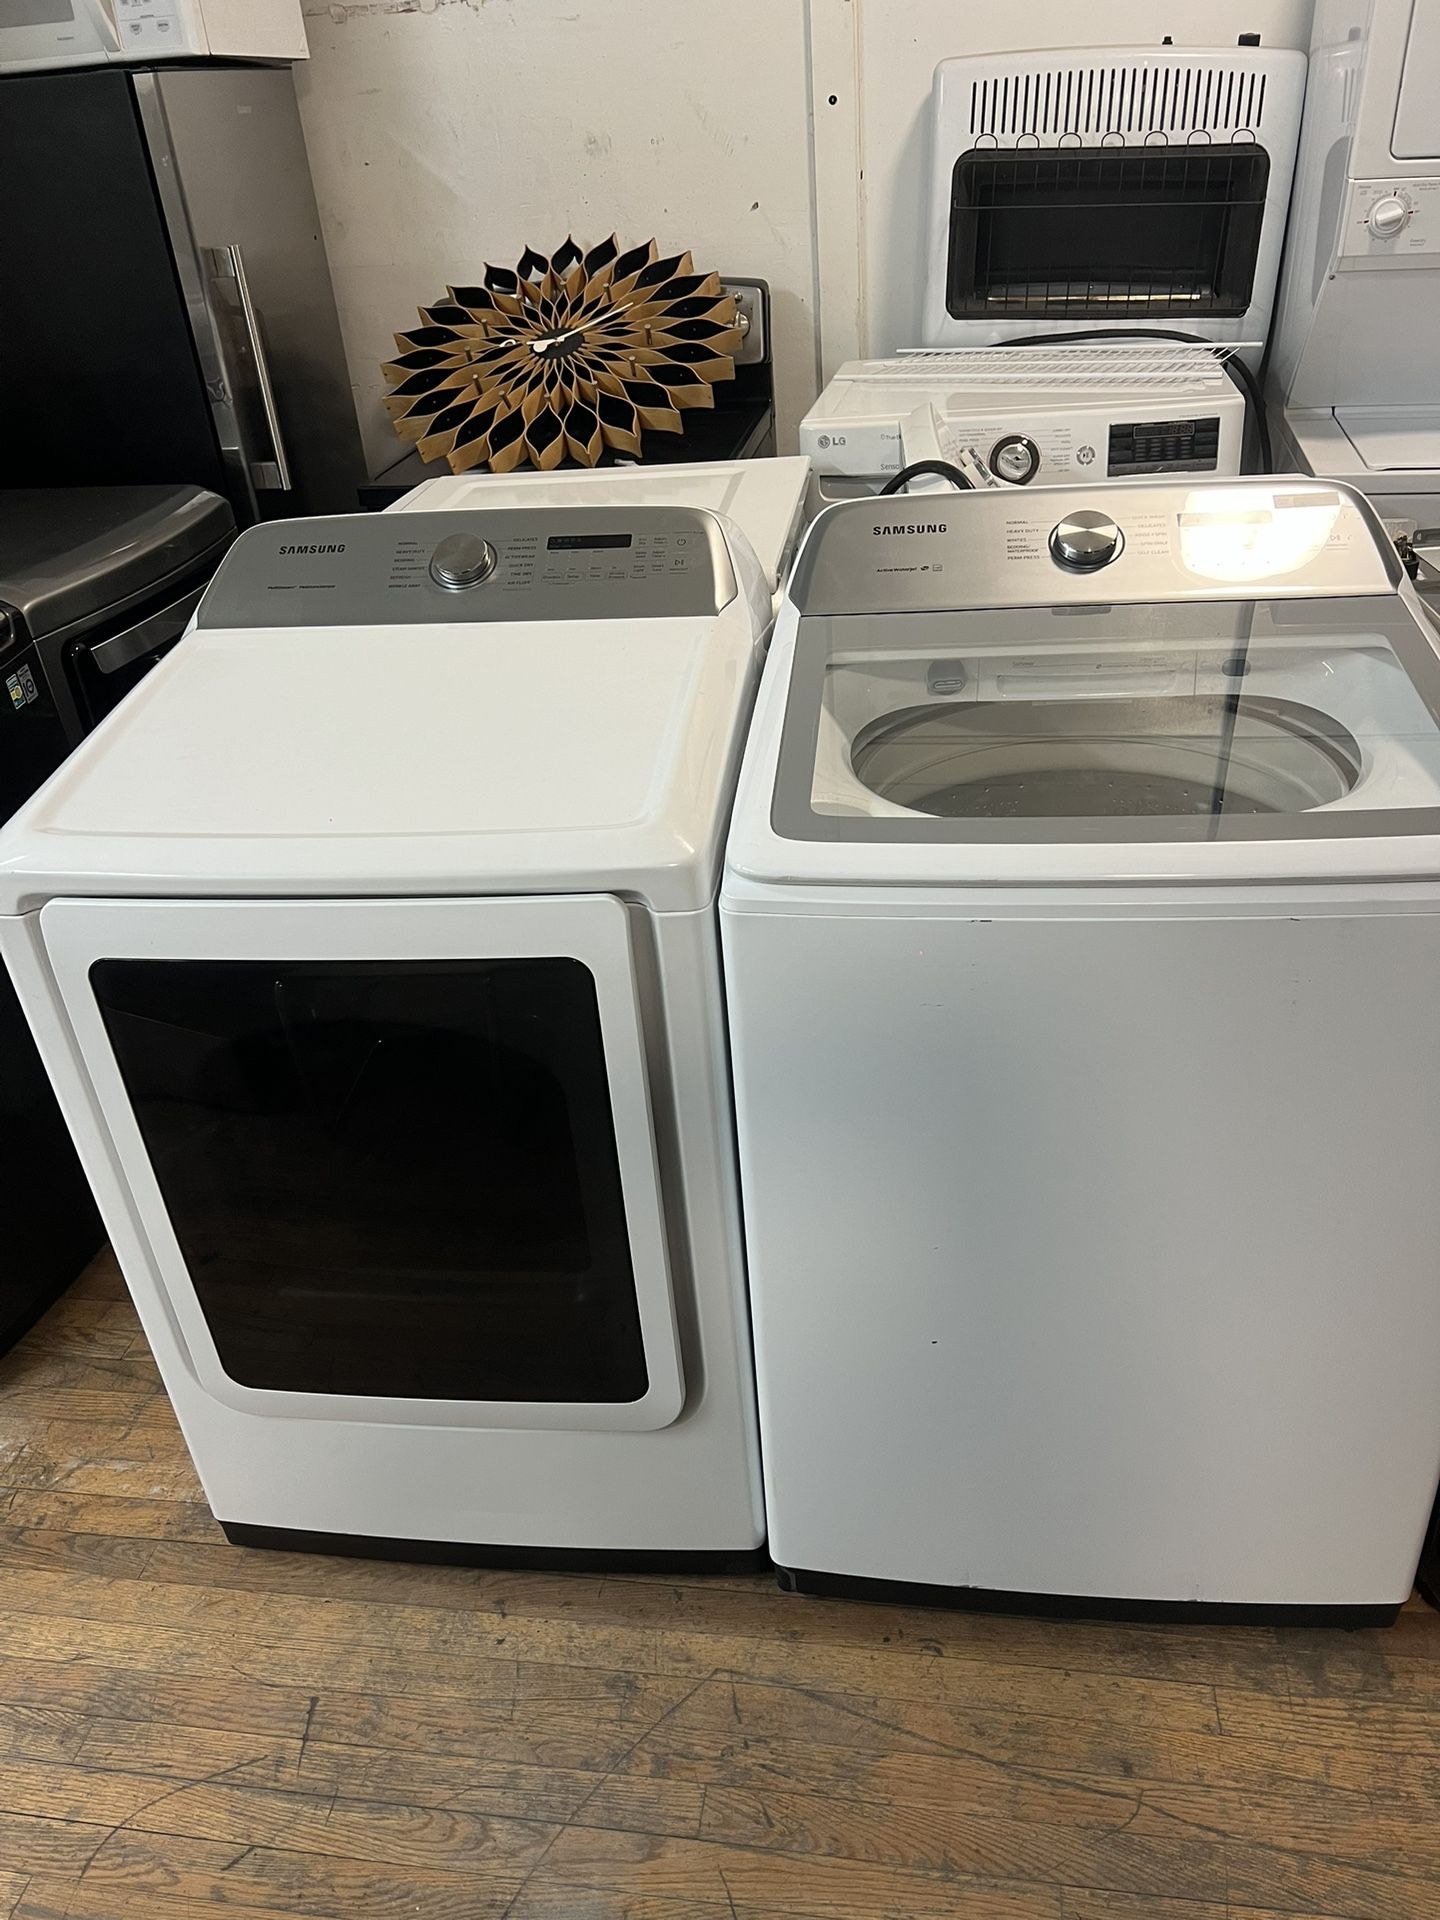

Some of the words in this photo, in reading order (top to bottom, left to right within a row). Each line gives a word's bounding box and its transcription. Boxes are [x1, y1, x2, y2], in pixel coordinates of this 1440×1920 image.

[832, 437, 846, 446] LG
[872, 523, 947, 536] SAMSUNG
[278, 543, 346, 555] SAMSUNG
